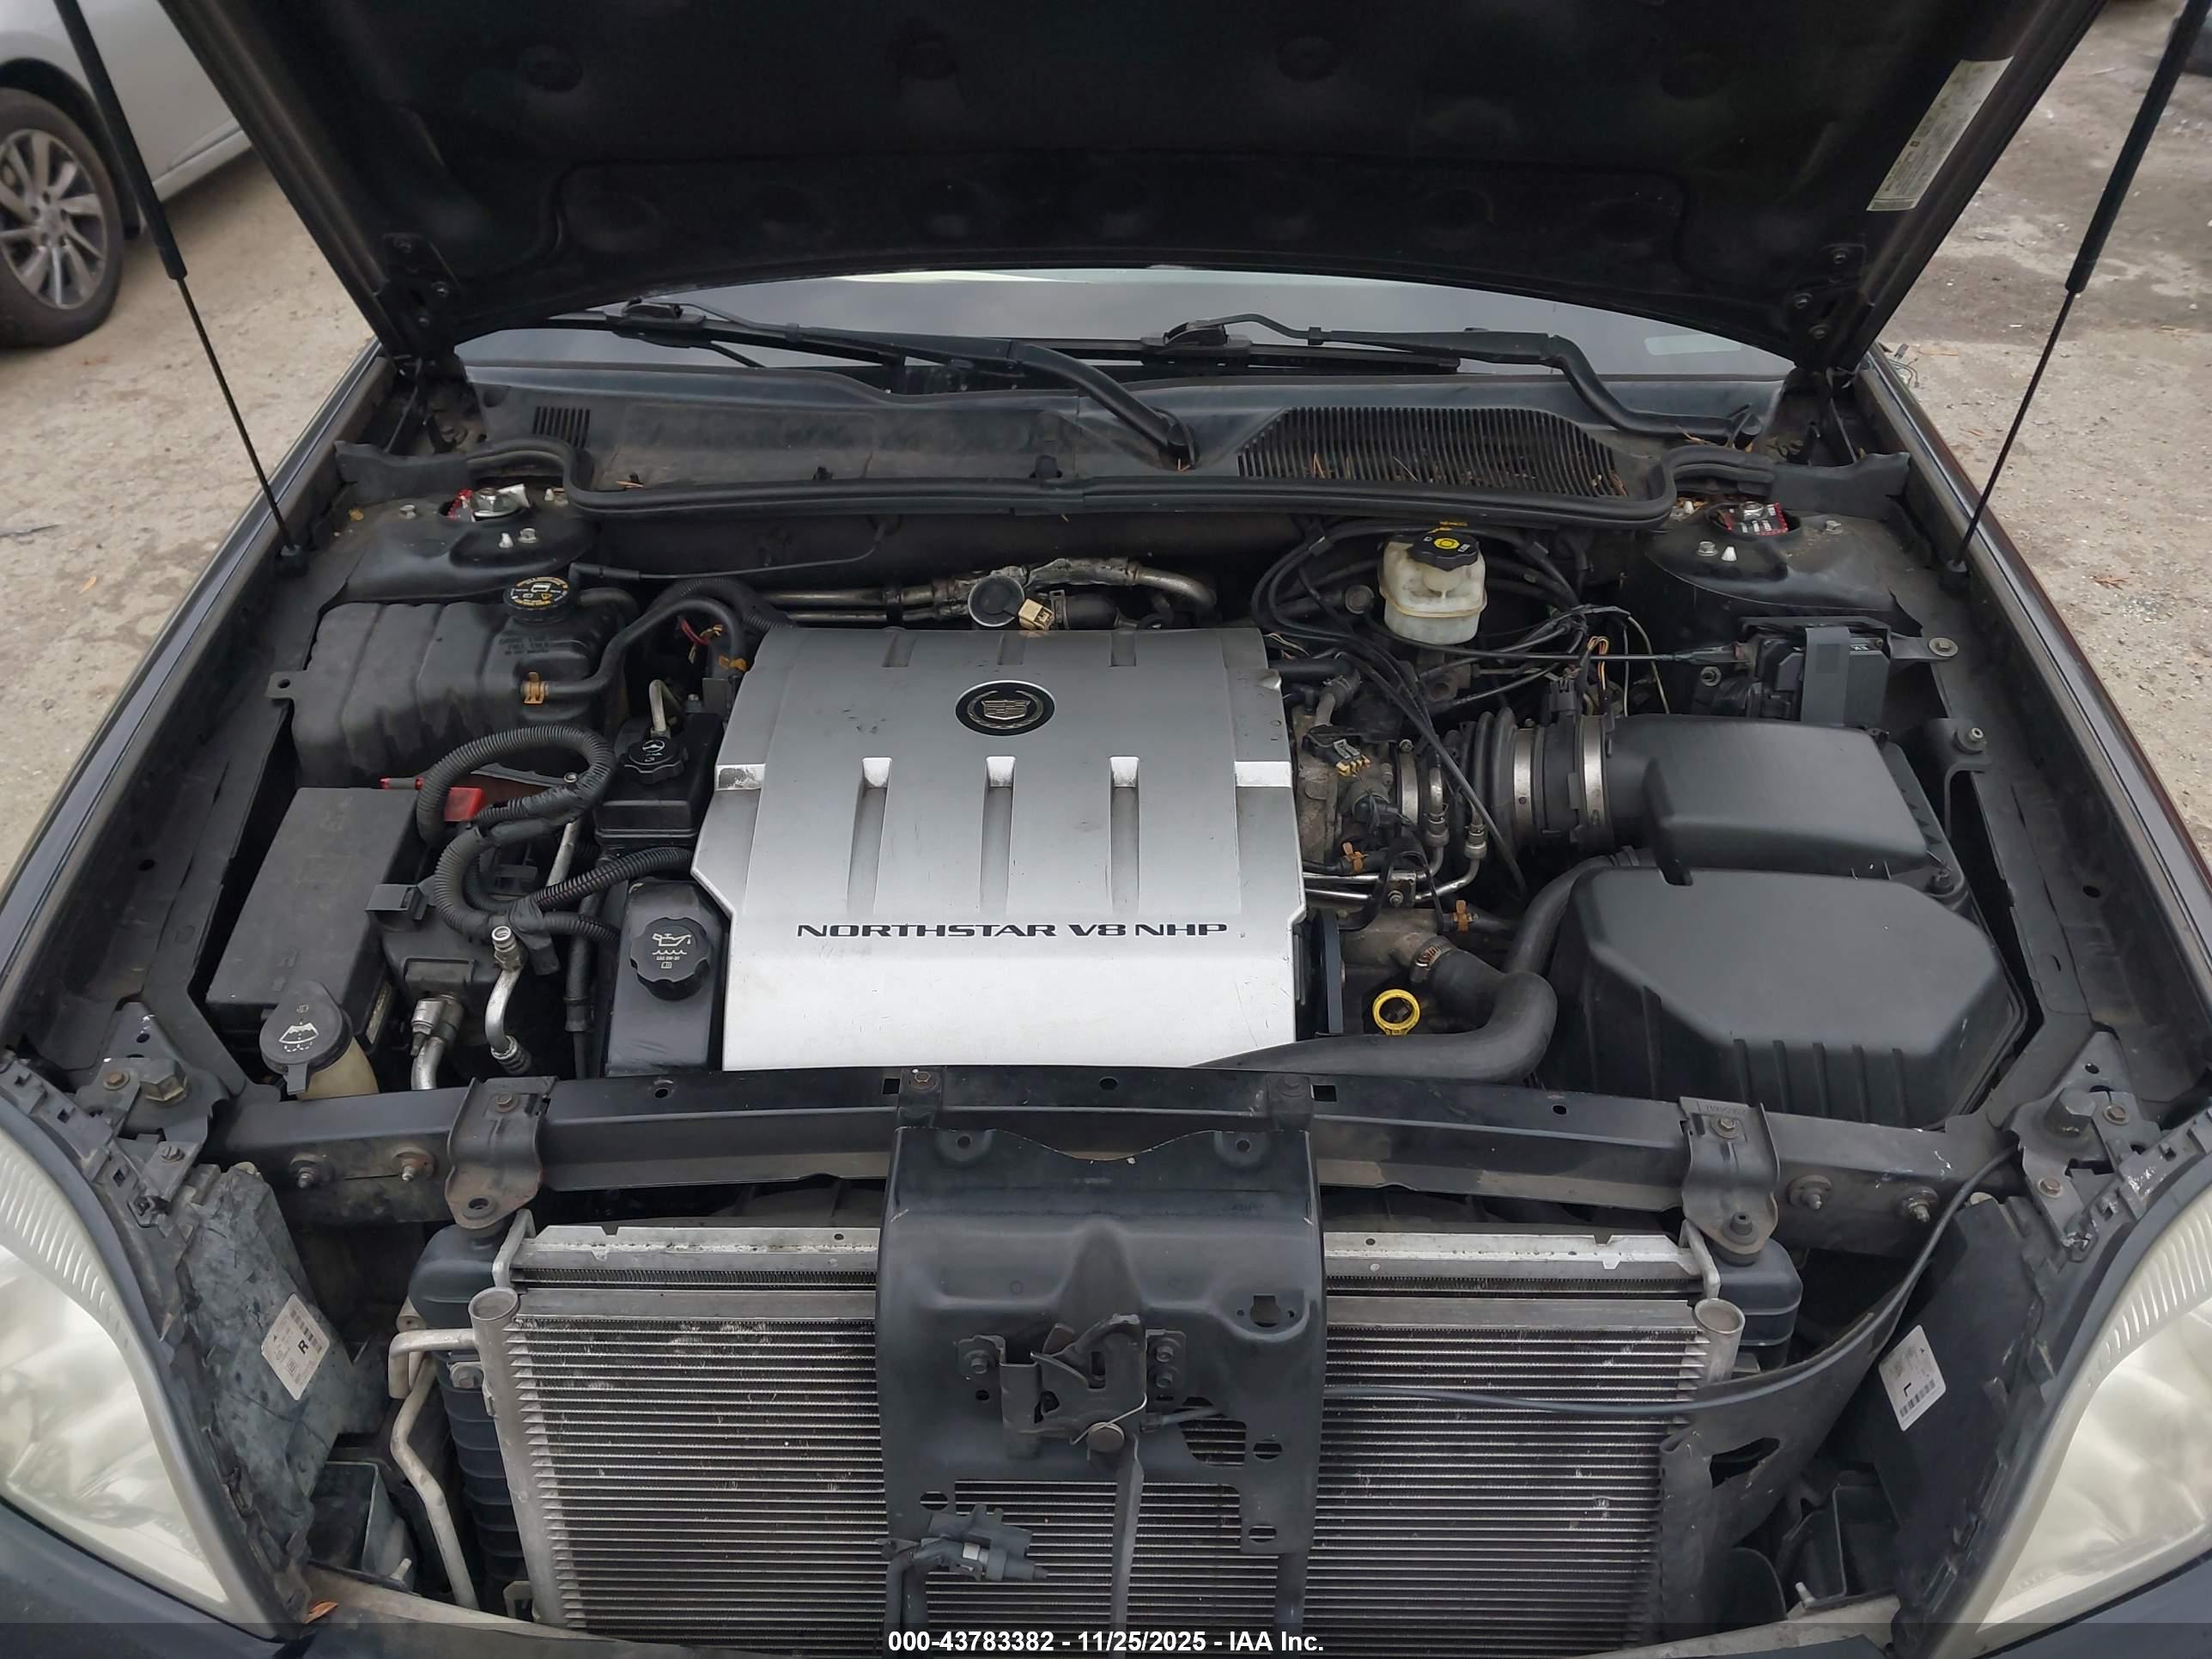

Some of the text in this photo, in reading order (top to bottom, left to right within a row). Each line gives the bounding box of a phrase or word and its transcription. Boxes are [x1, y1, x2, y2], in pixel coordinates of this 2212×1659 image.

[797, 923, 1227, 937] NORTHSTAR V8 NHP
[297, 1340, 309, 1354] R
[1903, 1382, 1912, 1397] L
